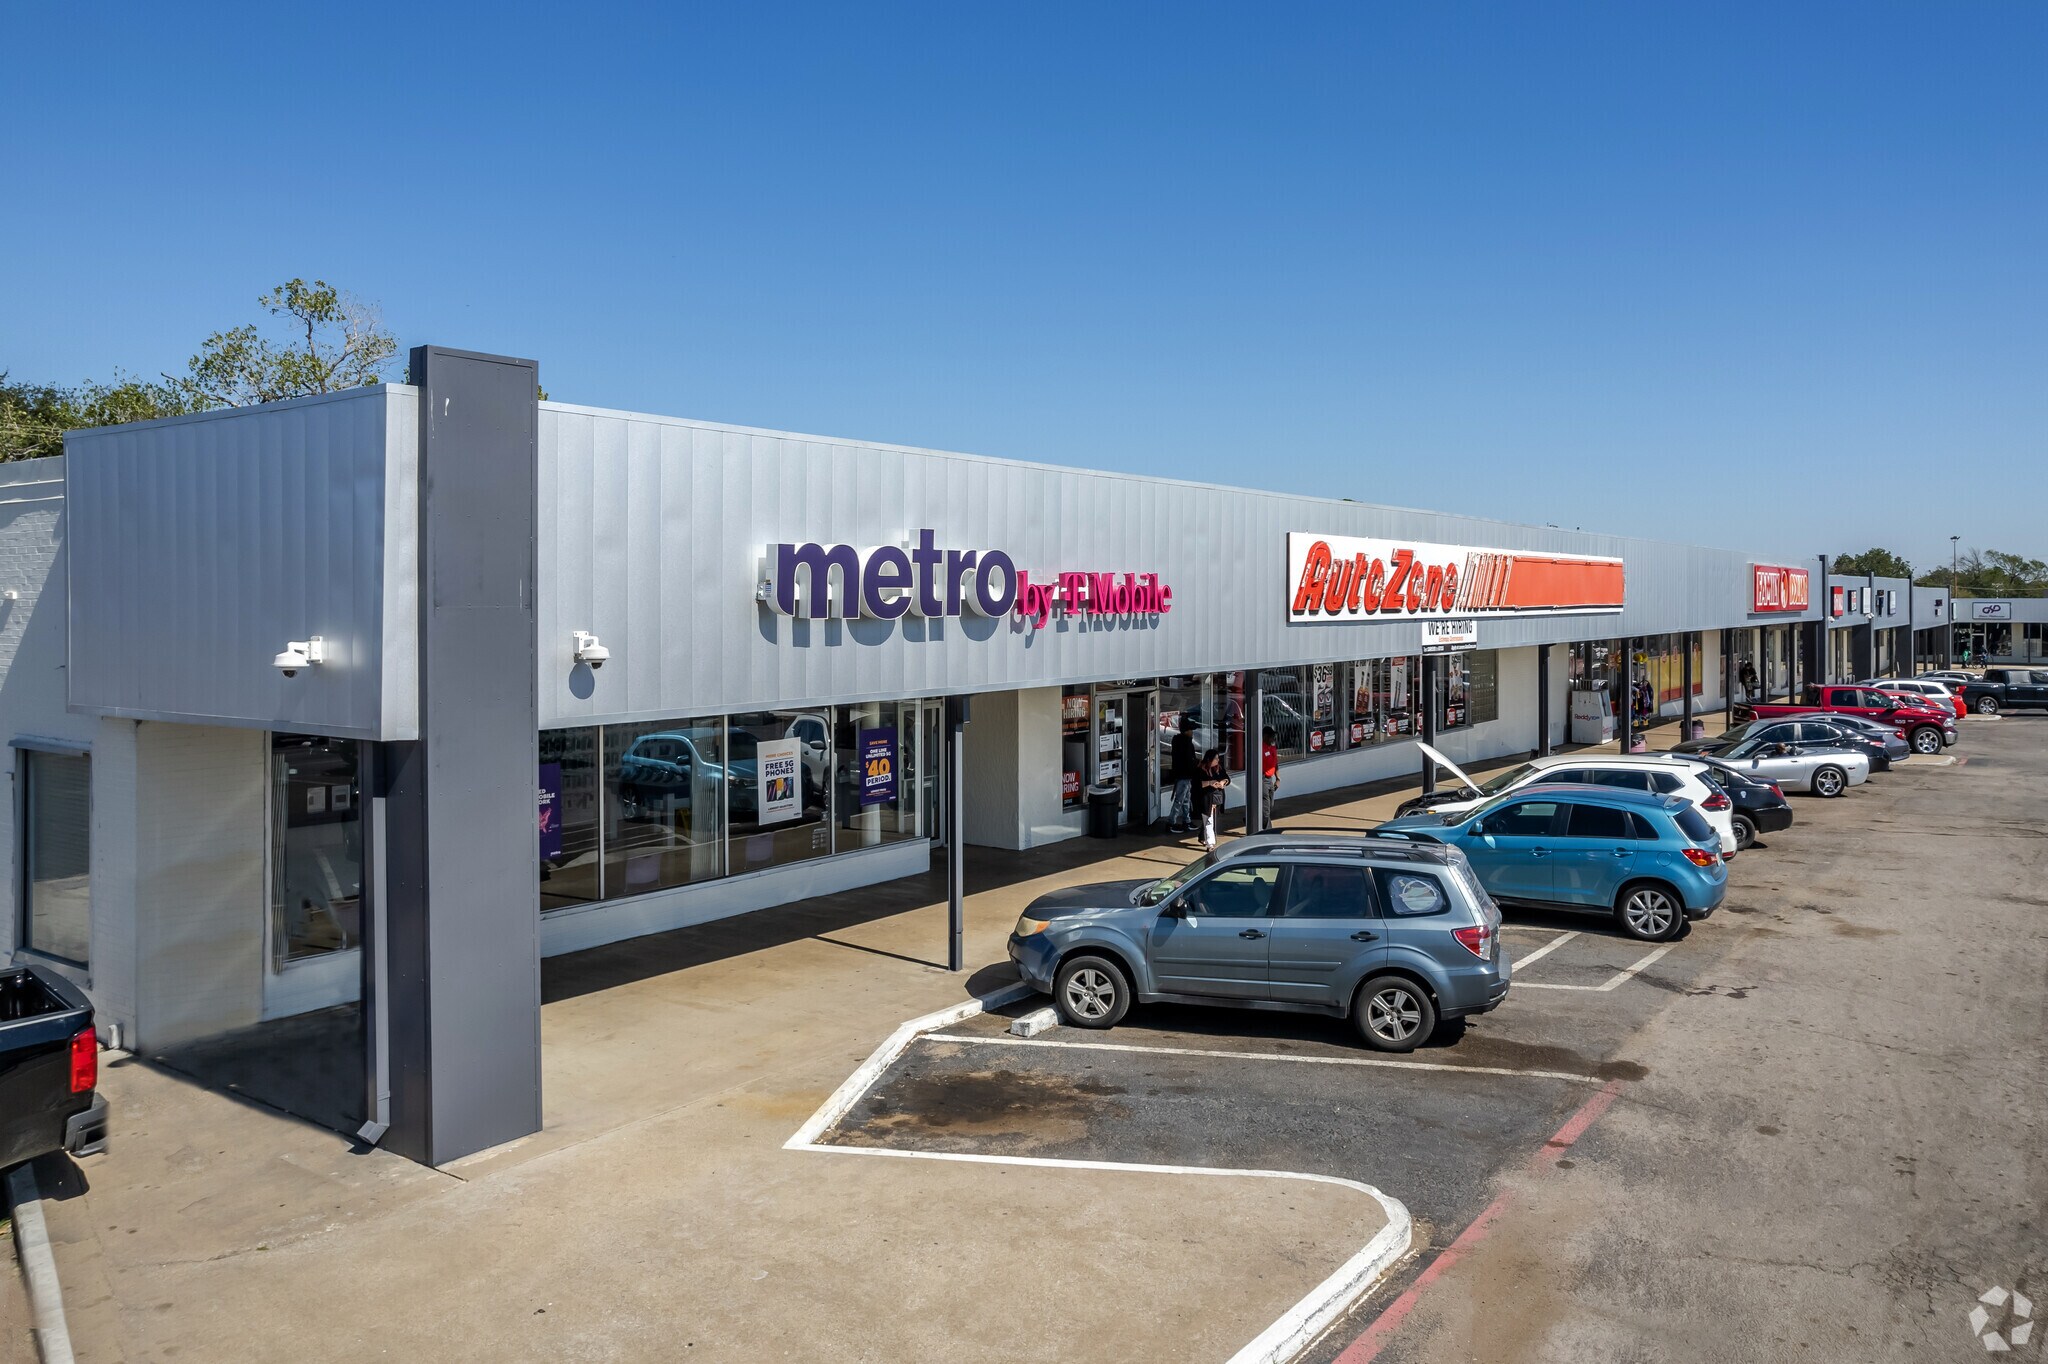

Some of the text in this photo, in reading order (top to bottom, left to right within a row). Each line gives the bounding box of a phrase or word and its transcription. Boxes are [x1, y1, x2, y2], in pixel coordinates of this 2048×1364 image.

[769, 528, 1017, 619] metro
[1017, 570, 1056, 629] by
[1293, 540, 1459, 613] AutoZone
[1757, 571, 1780, 606] FAMILY
[1789, 573, 1808, 605] DOLLAR
[1428, 618, 1473, 636] WE'RE HIRING
[1067, 697, 1083, 708] NOW
[1063, 707, 1086, 719] HIRING
[765, 760, 794, 771] FREE 5G
[765, 767, 794, 778] PHONES
